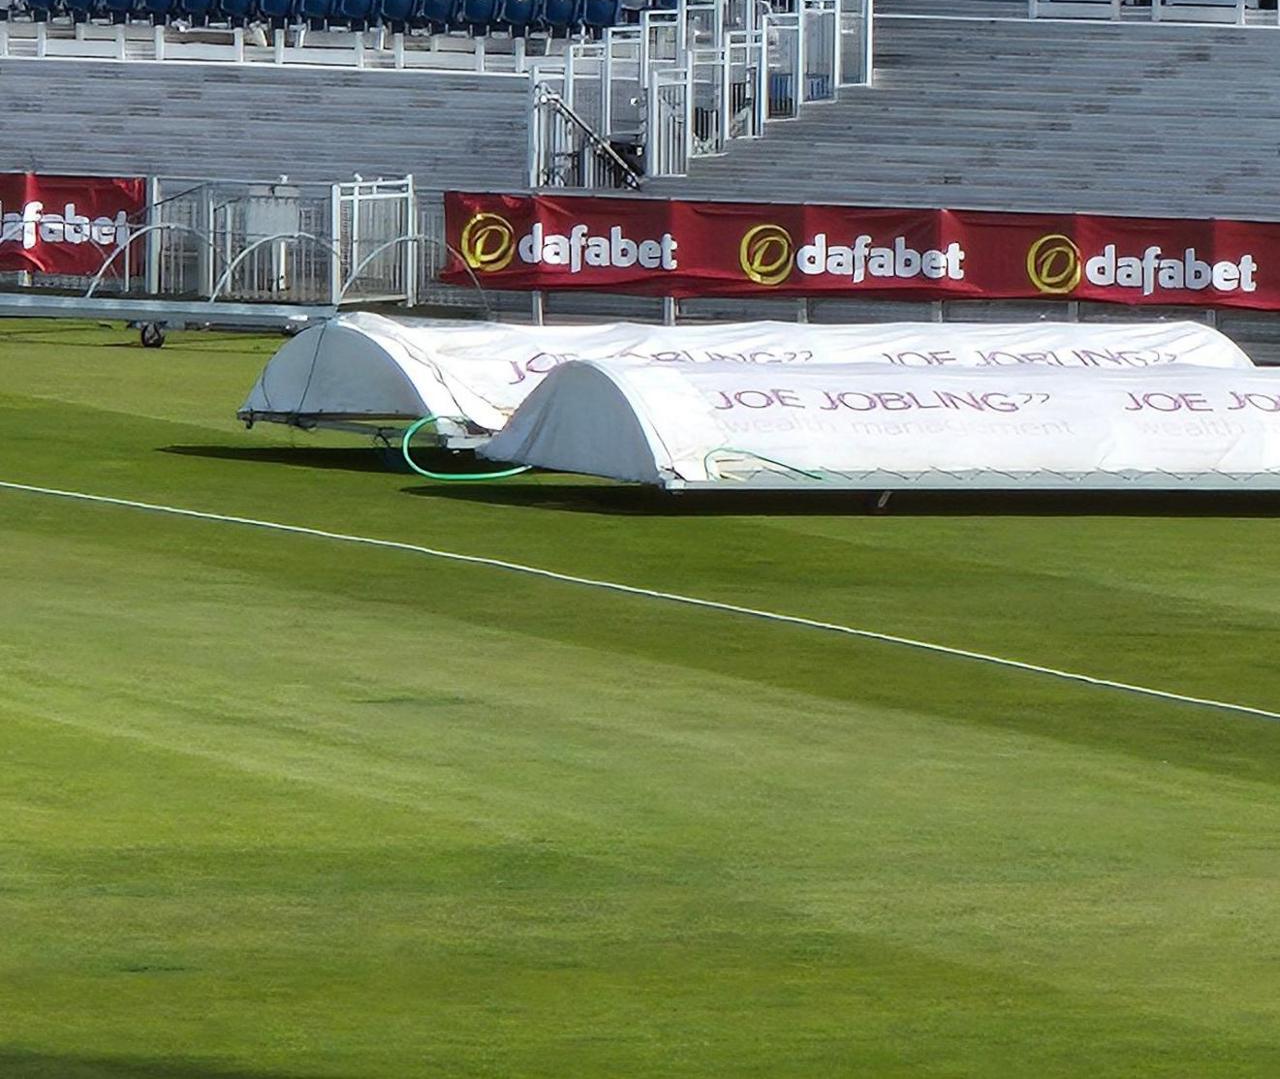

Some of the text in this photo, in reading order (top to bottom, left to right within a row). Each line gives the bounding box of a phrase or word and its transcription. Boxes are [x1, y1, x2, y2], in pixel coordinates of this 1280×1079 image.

[0, 201, 131, 250] afabet
[519, 223, 677, 272] dafabet
[797, 234, 965, 283] dafabet
[1085, 244, 1257, 295] dafabet
[714, 388, 805, 411] JOE
[1124, 391, 1214, 412] JOE
